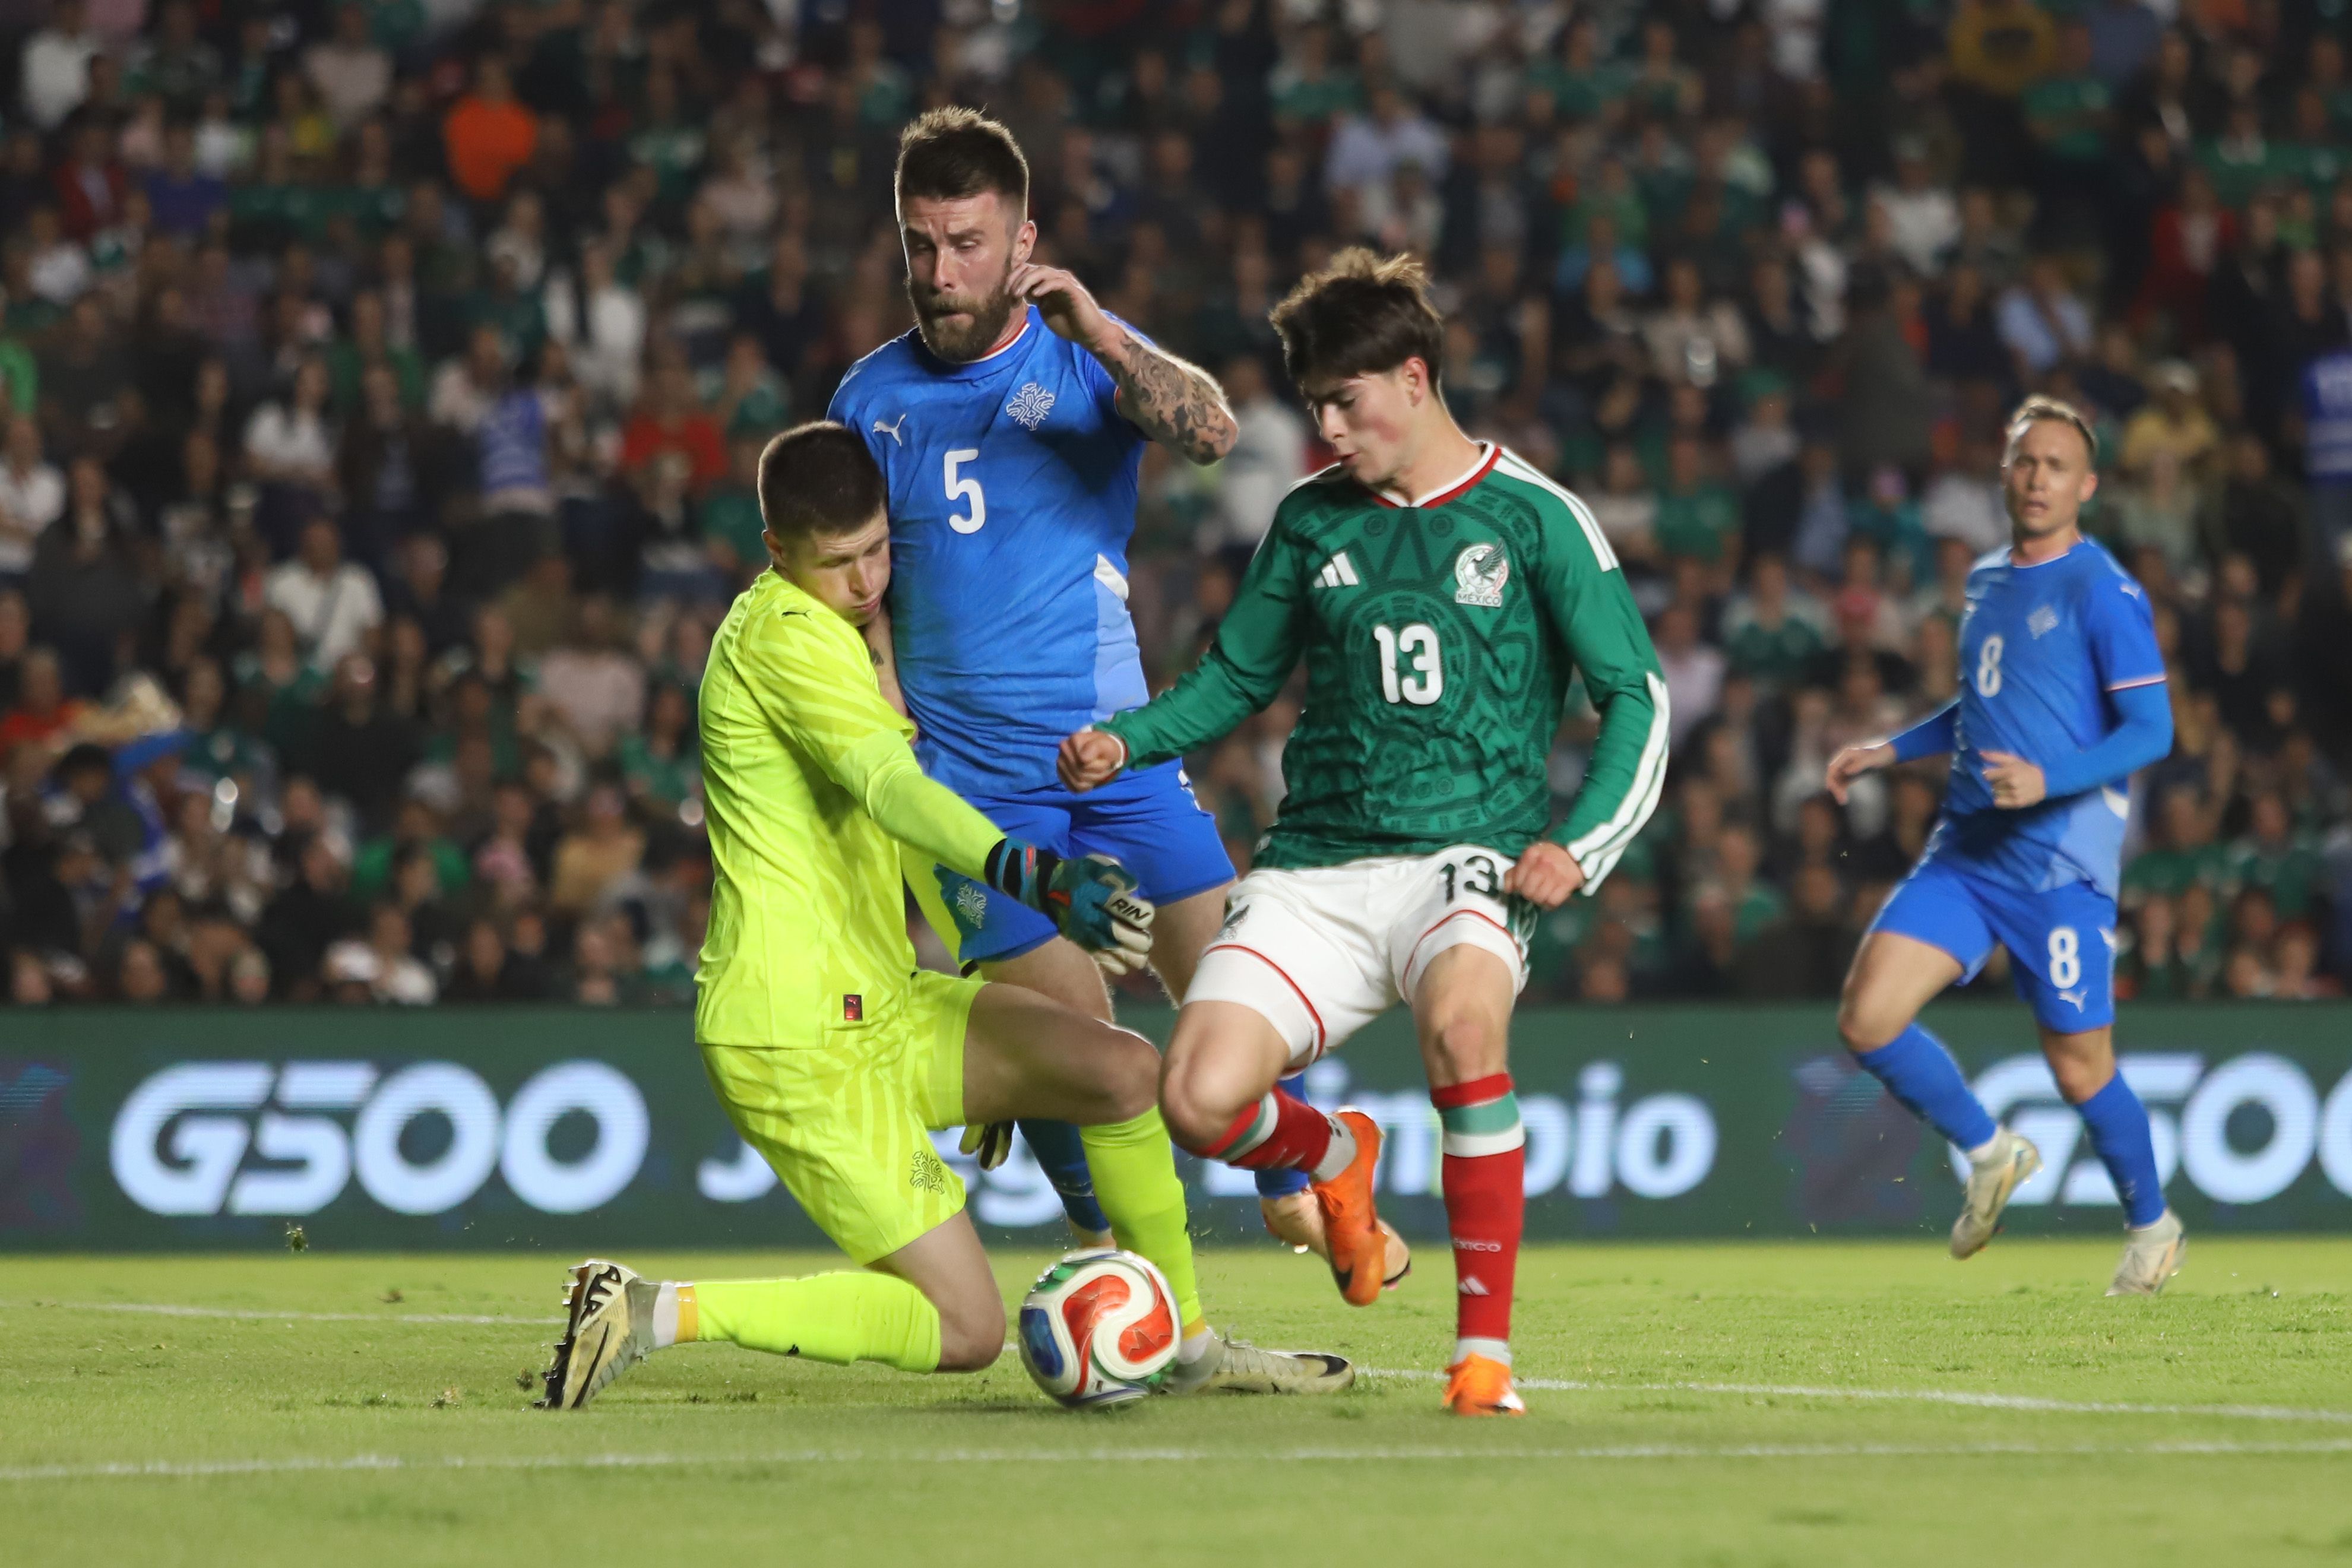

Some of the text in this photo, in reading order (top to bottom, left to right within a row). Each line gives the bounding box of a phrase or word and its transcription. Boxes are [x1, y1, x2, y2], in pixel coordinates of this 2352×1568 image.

[944, 448, 986, 534] 5
[1457, 593, 1501, 606] MÉXICO
[1373, 623, 1444, 705] 13
[1977, 635, 2004, 698] 8
[1439, 855, 1500, 904] 13
[2048, 927, 2081, 990] 8
[110, 1059, 650, 1216] G500
